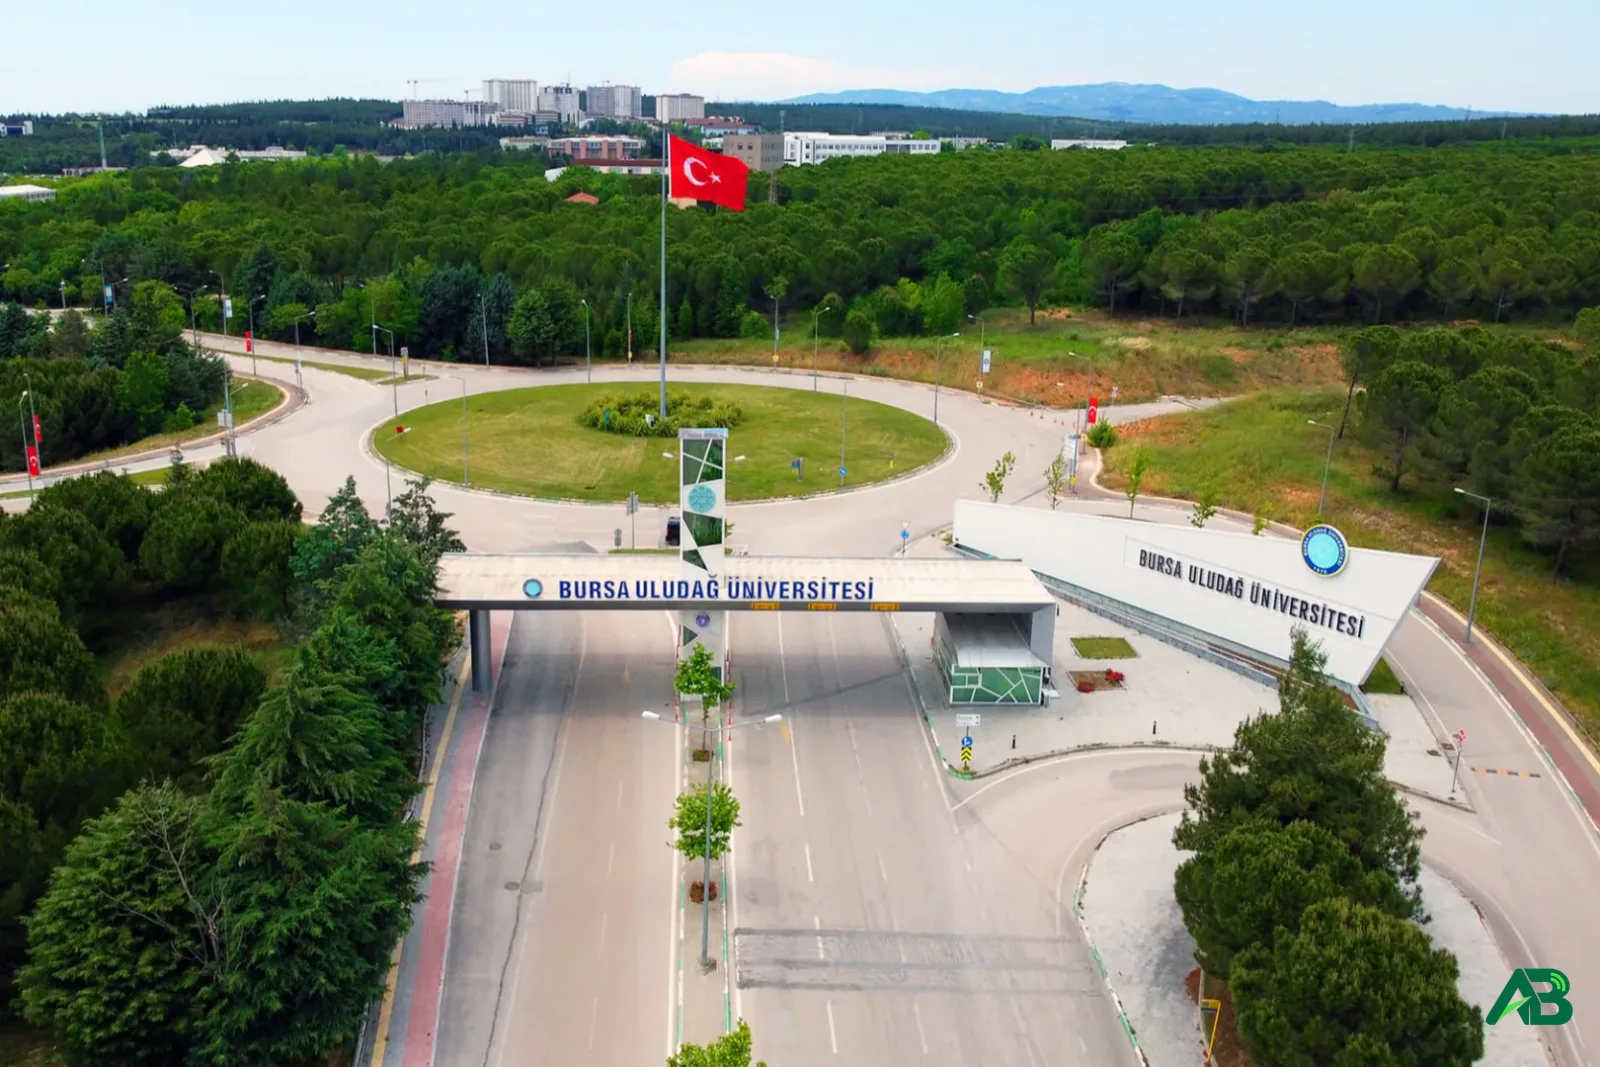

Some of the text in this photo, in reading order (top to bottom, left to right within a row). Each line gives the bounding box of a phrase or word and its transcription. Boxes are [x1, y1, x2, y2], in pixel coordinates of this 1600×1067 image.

[559, 574, 873, 600] BURSA ULUDAĞ ÜNİVERSİTESİ
[1138, 549, 1365, 639] BURSA ULUDAĞ ÜNİVERSİTESİ
